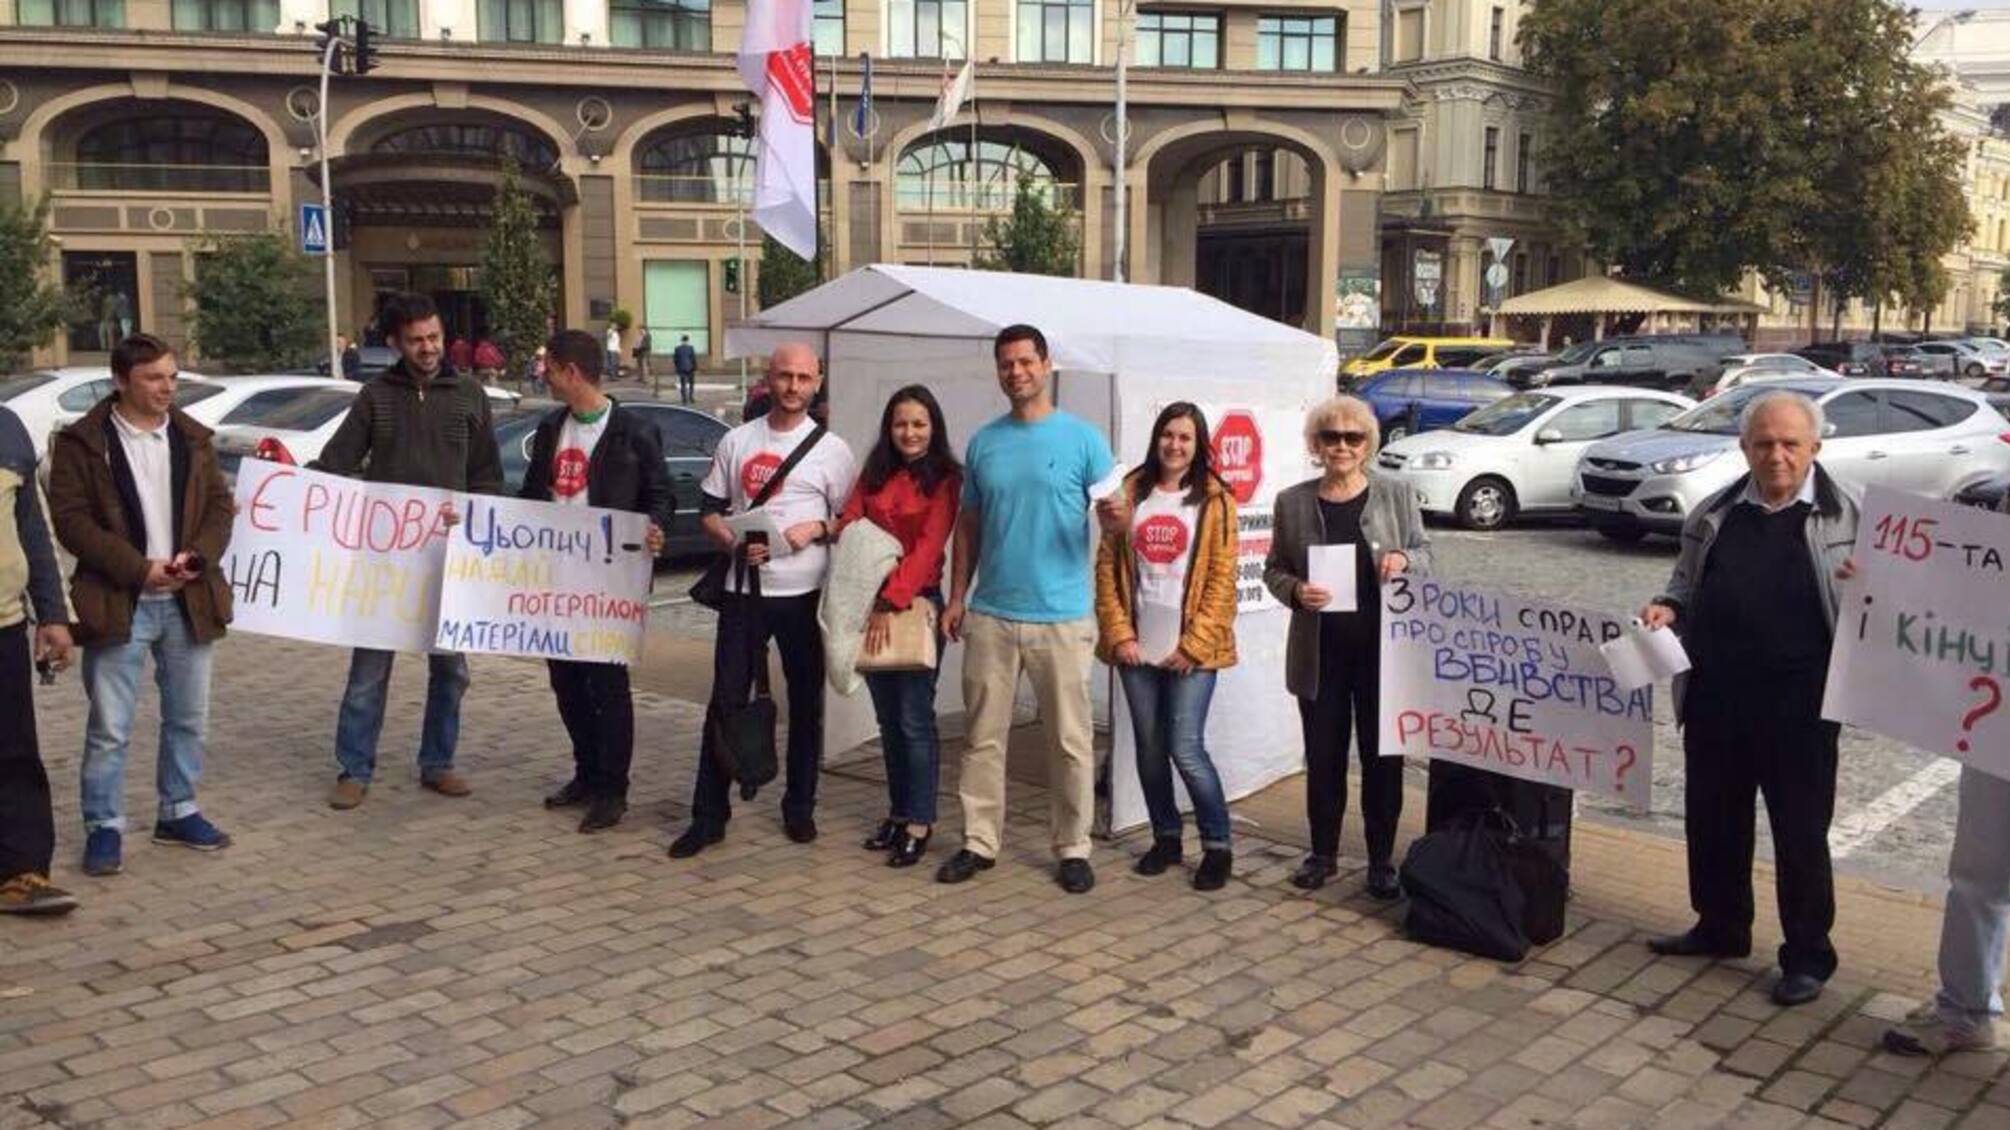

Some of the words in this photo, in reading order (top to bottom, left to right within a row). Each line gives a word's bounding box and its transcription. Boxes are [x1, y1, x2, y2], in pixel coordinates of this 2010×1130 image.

[1146, 525, 1178, 543] STOP
[230, 549, 282, 608] НА
[1422, 583, 1500, 628] РОКИ
[1460, 688, 1536, 734] ДЕ
